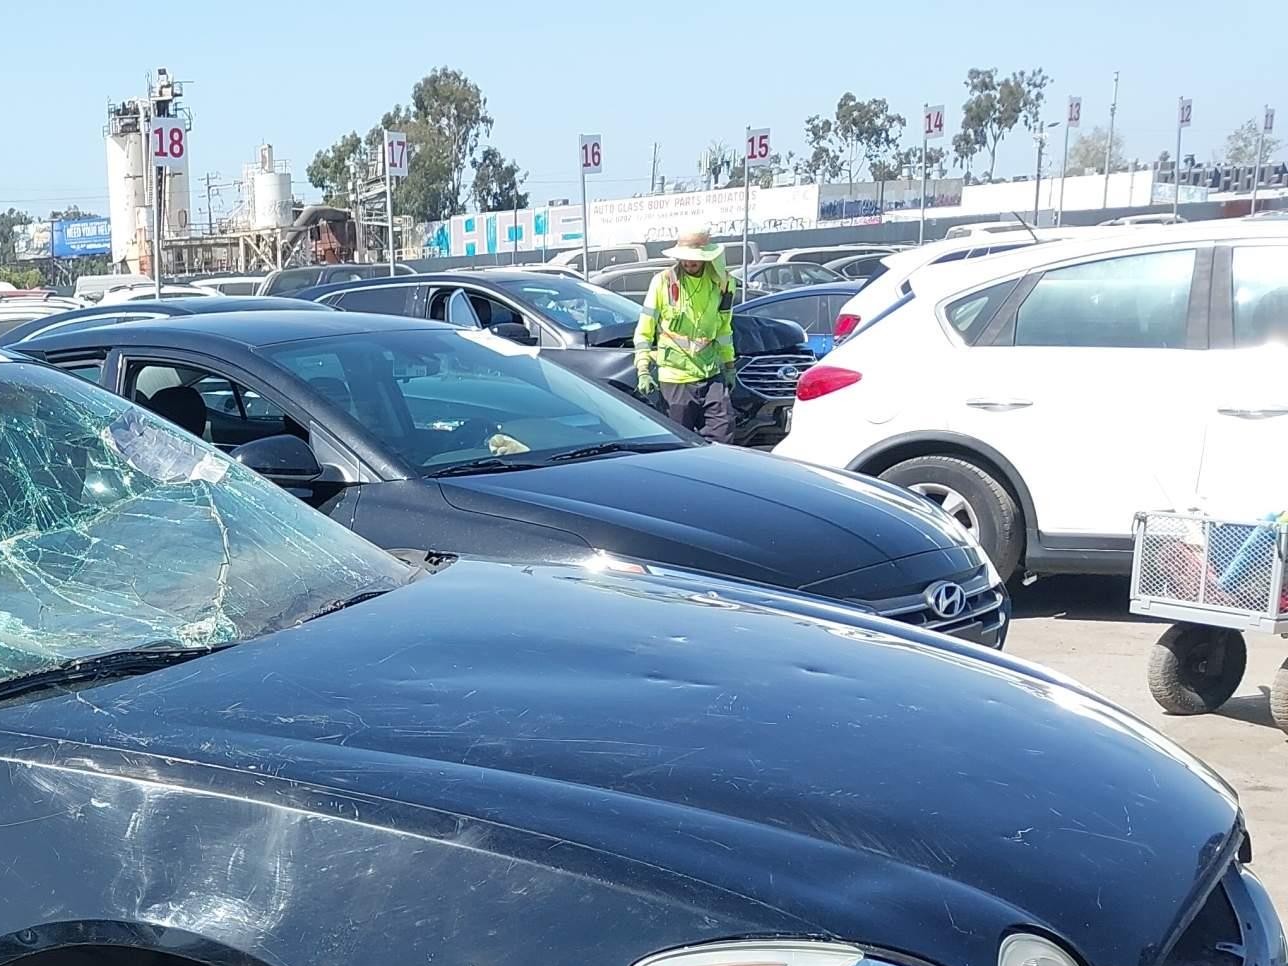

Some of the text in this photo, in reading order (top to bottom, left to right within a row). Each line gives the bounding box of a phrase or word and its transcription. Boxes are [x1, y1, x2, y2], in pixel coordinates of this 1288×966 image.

[925, 111, 943, 134] 14
[1068, 102, 1081, 121] 13
[1180, 104, 1192, 124] 12
[1264, 113, 1274, 130] 11
[154, 127, 184, 158] 18
[388, 140, 406, 168] 17
[582, 142, 601, 167] 16
[747, 134, 769, 159] 15
[593, 190, 758, 215] AUTO GLASS BODY PARTS RADIATOS
